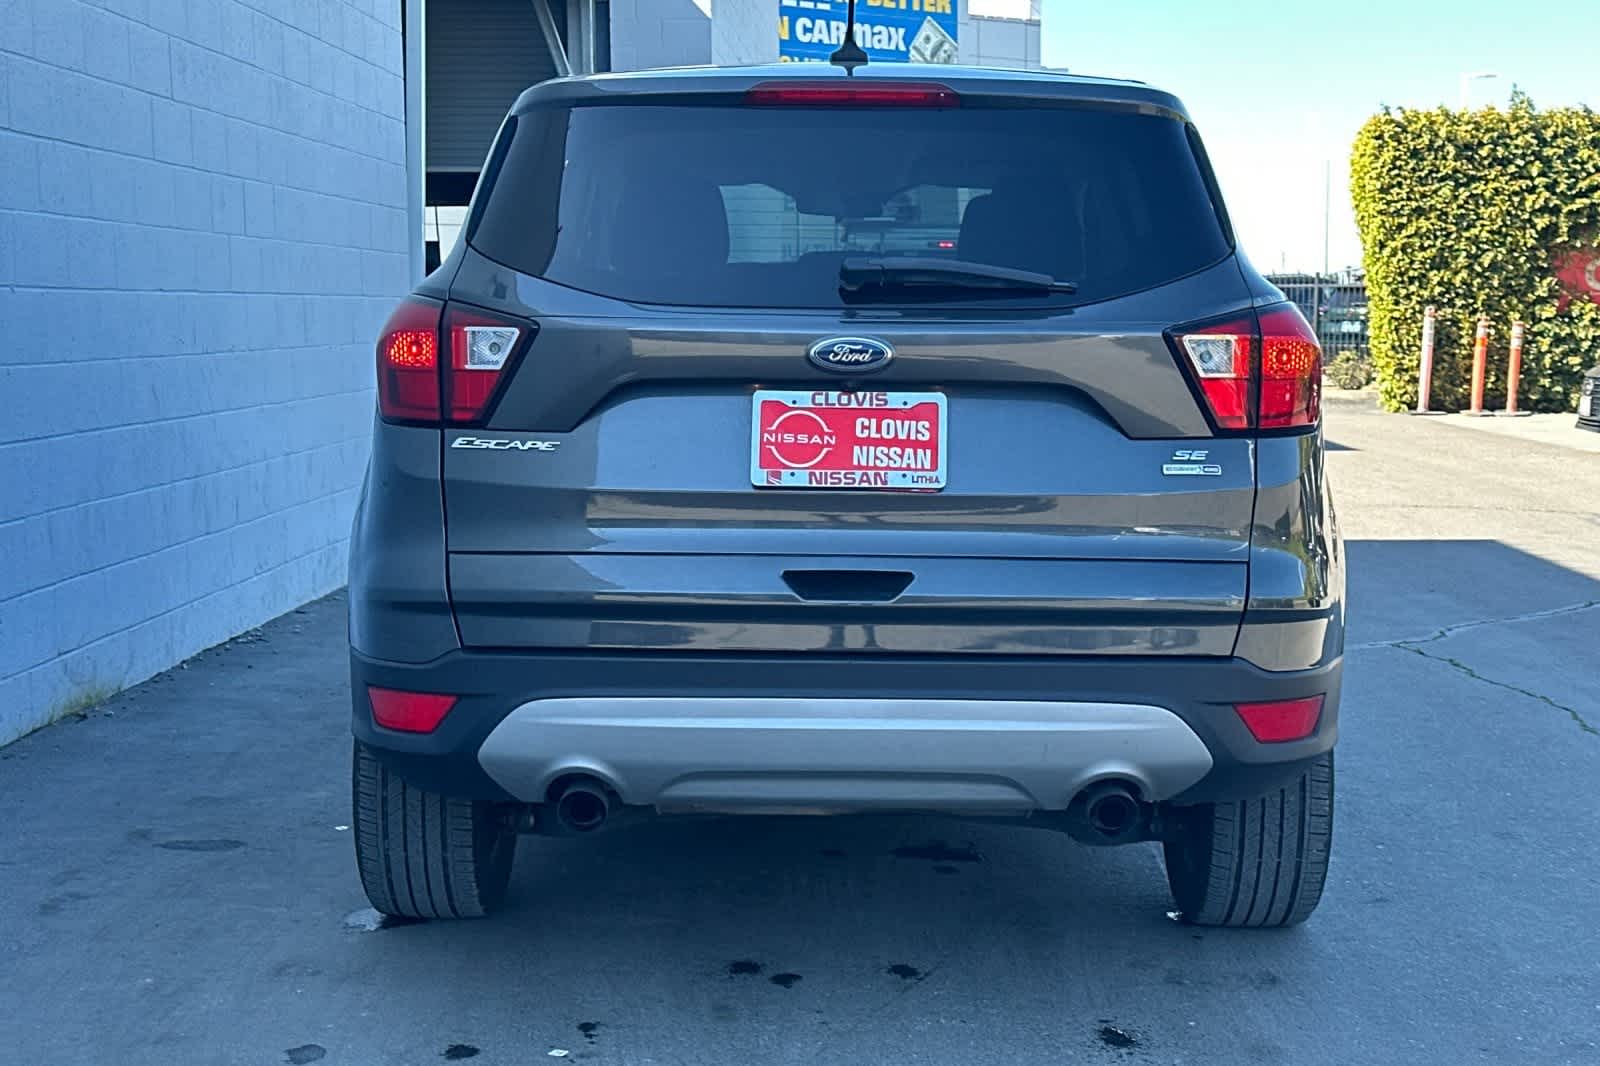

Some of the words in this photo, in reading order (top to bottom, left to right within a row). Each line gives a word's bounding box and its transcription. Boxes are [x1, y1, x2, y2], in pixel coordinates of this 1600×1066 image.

[829, 343, 873, 362] Ford
[811, 392, 888, 407] CLOVIS
[856, 418, 930, 441] CLOVIS
[451, 437, 561, 451] ESCAPE
[763, 433, 836, 445] NISSAN
[853, 446, 931, 469] NISSAN
[1172, 450, 1209, 460] SE
[808, 471, 888, 486] NISSAN
